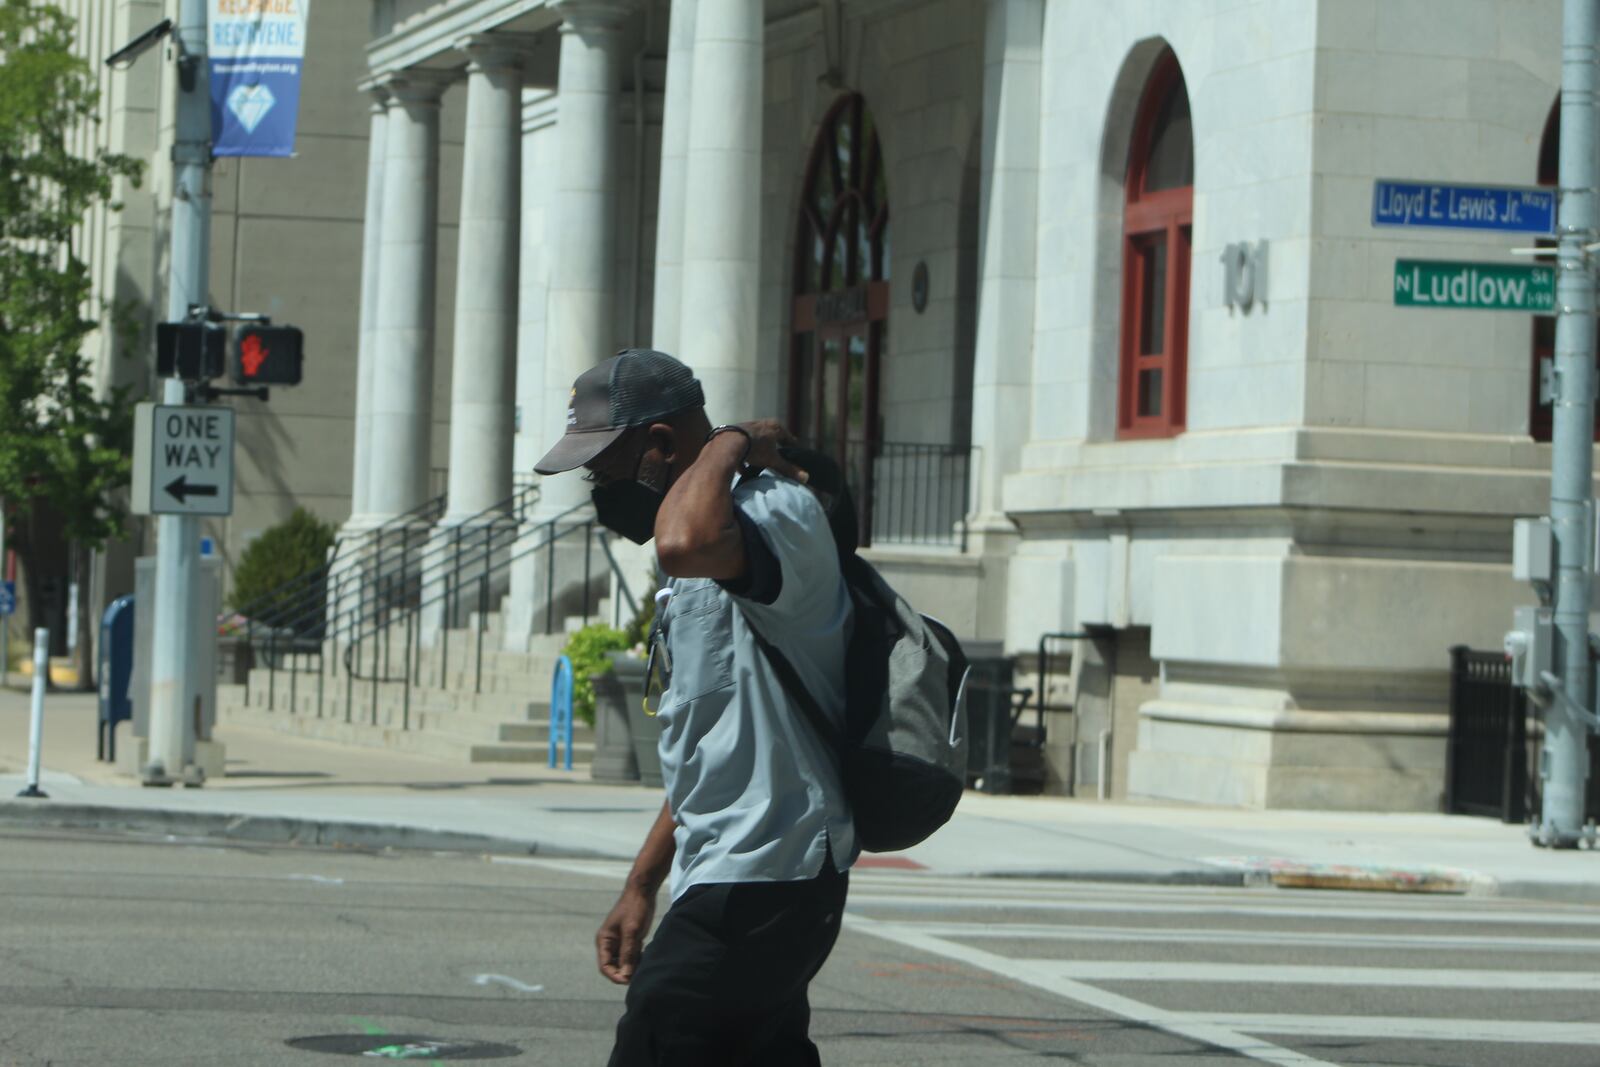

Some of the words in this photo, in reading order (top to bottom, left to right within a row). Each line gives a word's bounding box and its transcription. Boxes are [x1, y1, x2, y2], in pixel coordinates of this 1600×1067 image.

[1379, 186, 1424, 224] Lloyd
[1429, 188, 1443, 219] E.
[1448, 189, 1496, 221] Lewis
[1500, 191, 1523, 223] Jr.
[1521, 192, 1549, 210] Way
[1396, 274, 1409, 292] N
[1412, 267, 1526, 304] Ludlow
[1531, 270, 1549, 285] St
[166, 415, 220, 439] ONE
[164, 444, 221, 469] WAY
